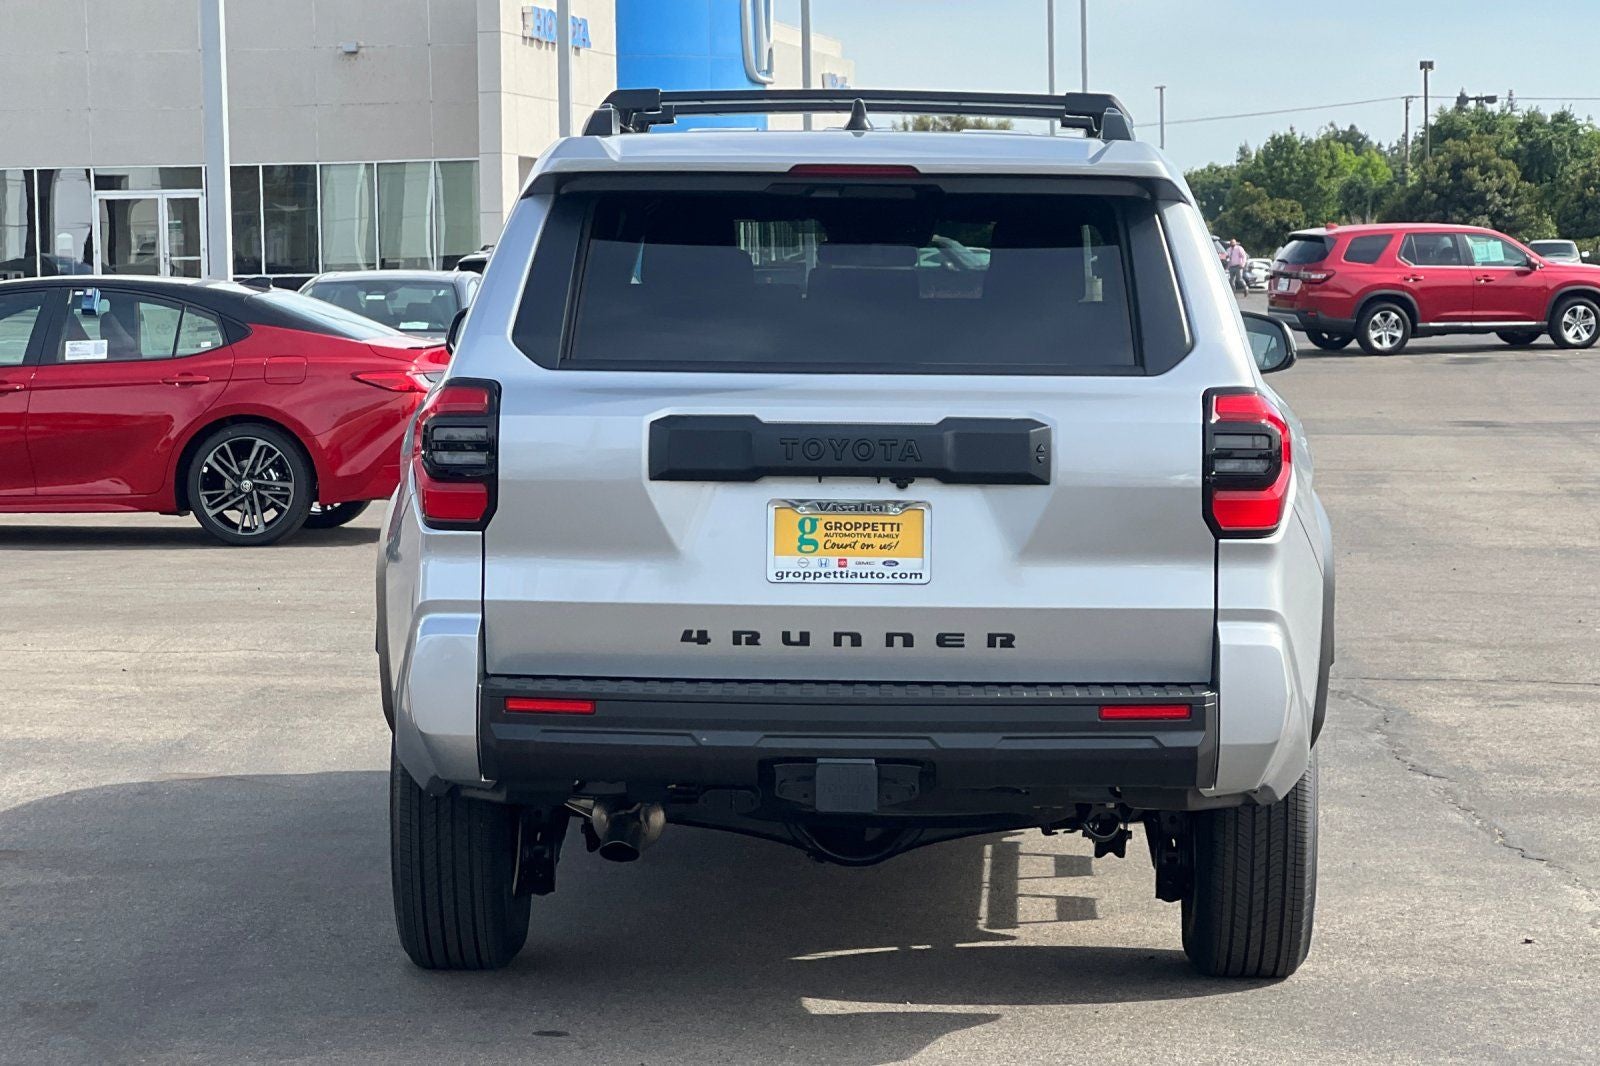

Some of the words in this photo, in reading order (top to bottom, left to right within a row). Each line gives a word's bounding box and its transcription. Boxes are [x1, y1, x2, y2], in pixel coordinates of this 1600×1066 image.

[529, 6, 592, 49] HODA
[779, 437, 922, 462] TOYOTA
[816, 502, 884, 513] Visalia
[823, 521, 900, 532] GROPPETTI
[823, 532, 872, 540] AUTOMOTIVE
[873, 532, 900, 540] FAMILY
[823, 539, 858, 550] Count
[879, 540, 900, 550] us!
[775, 569, 923, 581] groppettiauto.com
[680, 629, 1016, 649] 4RUNNER
